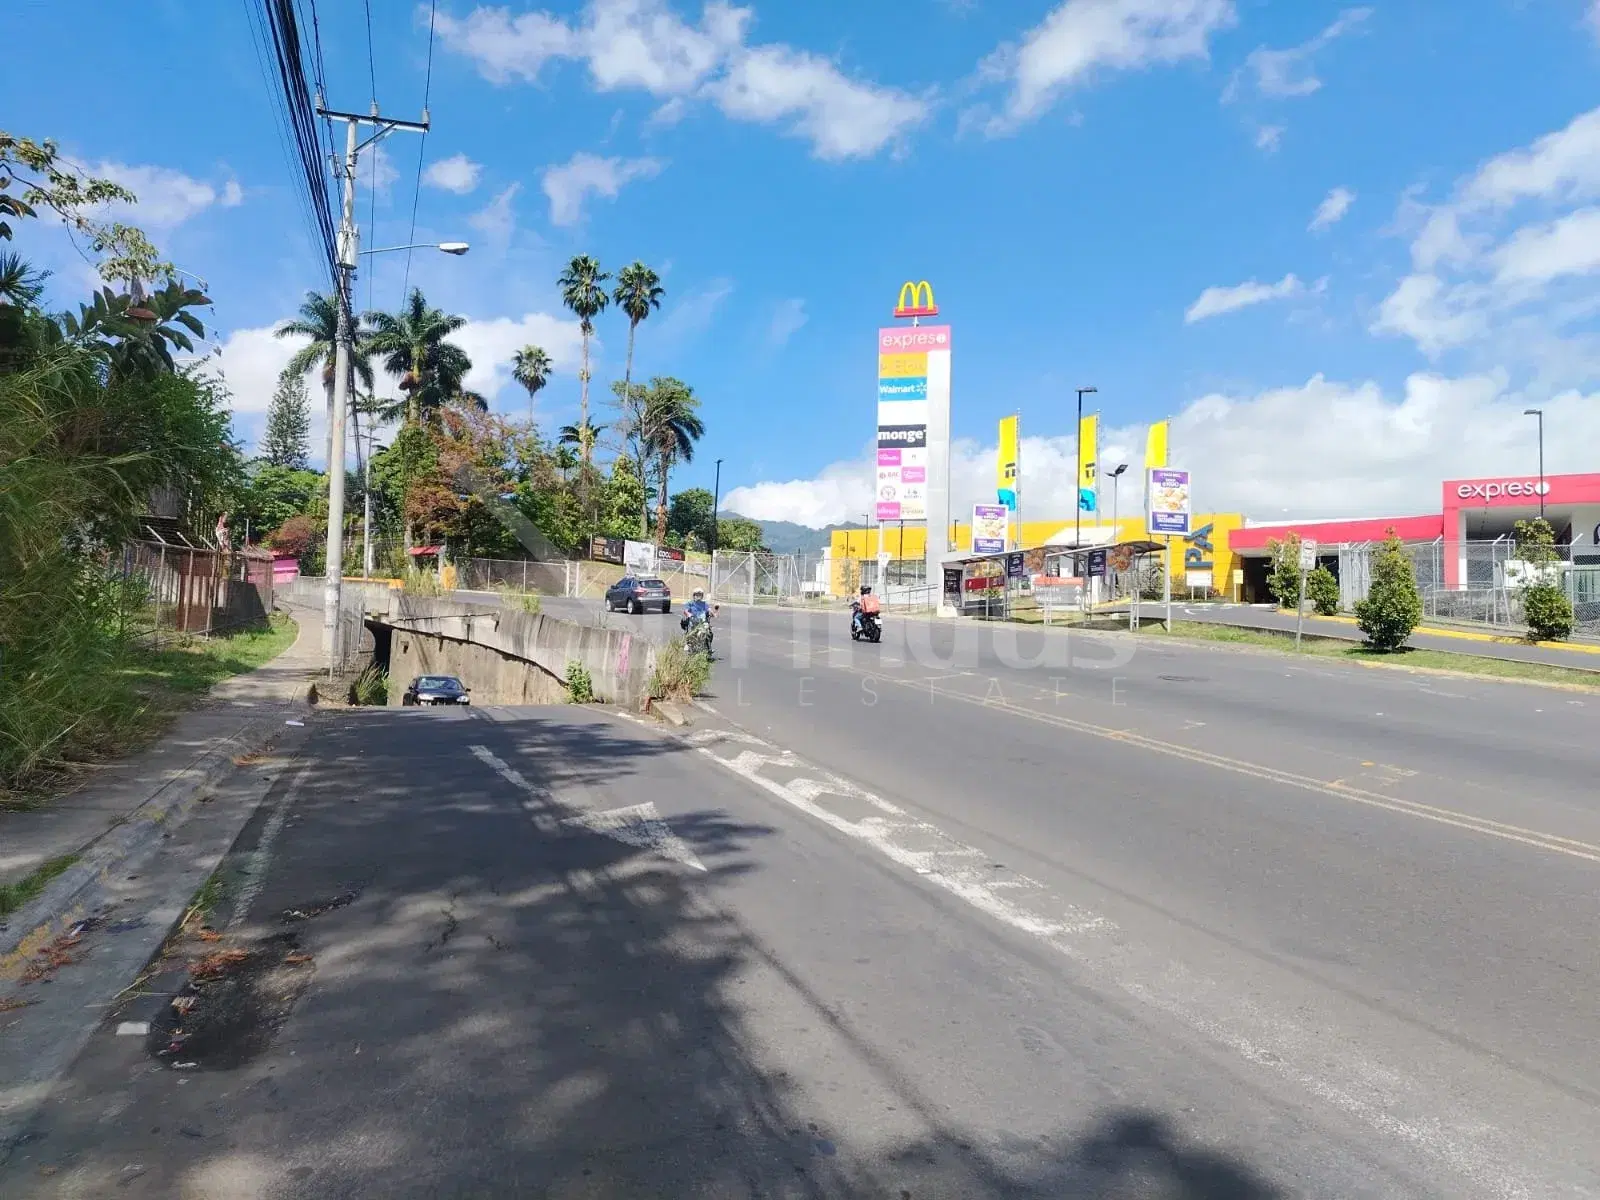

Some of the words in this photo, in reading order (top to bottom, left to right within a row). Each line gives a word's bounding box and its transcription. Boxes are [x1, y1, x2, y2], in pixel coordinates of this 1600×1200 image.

[882, 333, 947, 349] expreso
[880, 384, 915, 394] Walmart
[878, 430, 924, 443] monge
[1457, 480, 1550, 502] expreso
